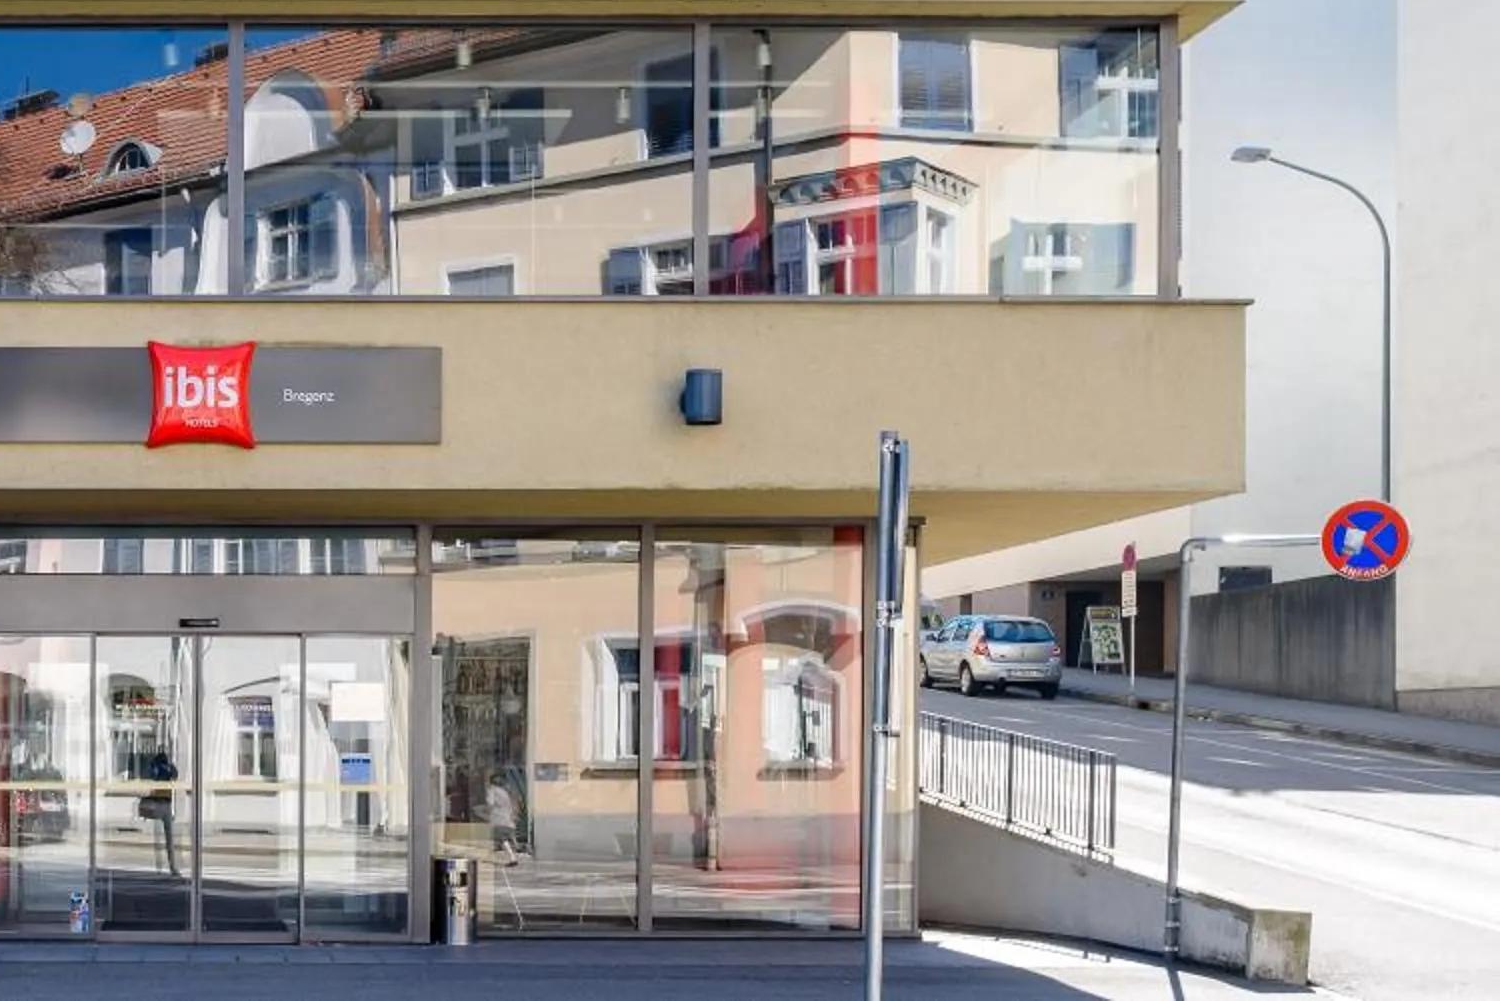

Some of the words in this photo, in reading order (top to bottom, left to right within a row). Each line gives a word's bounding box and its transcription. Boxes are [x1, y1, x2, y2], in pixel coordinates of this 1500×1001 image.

[163, 365, 239, 408] ibis
[283, 389, 335, 405] Bregenz
[184, 418, 219, 428] HOTELS
